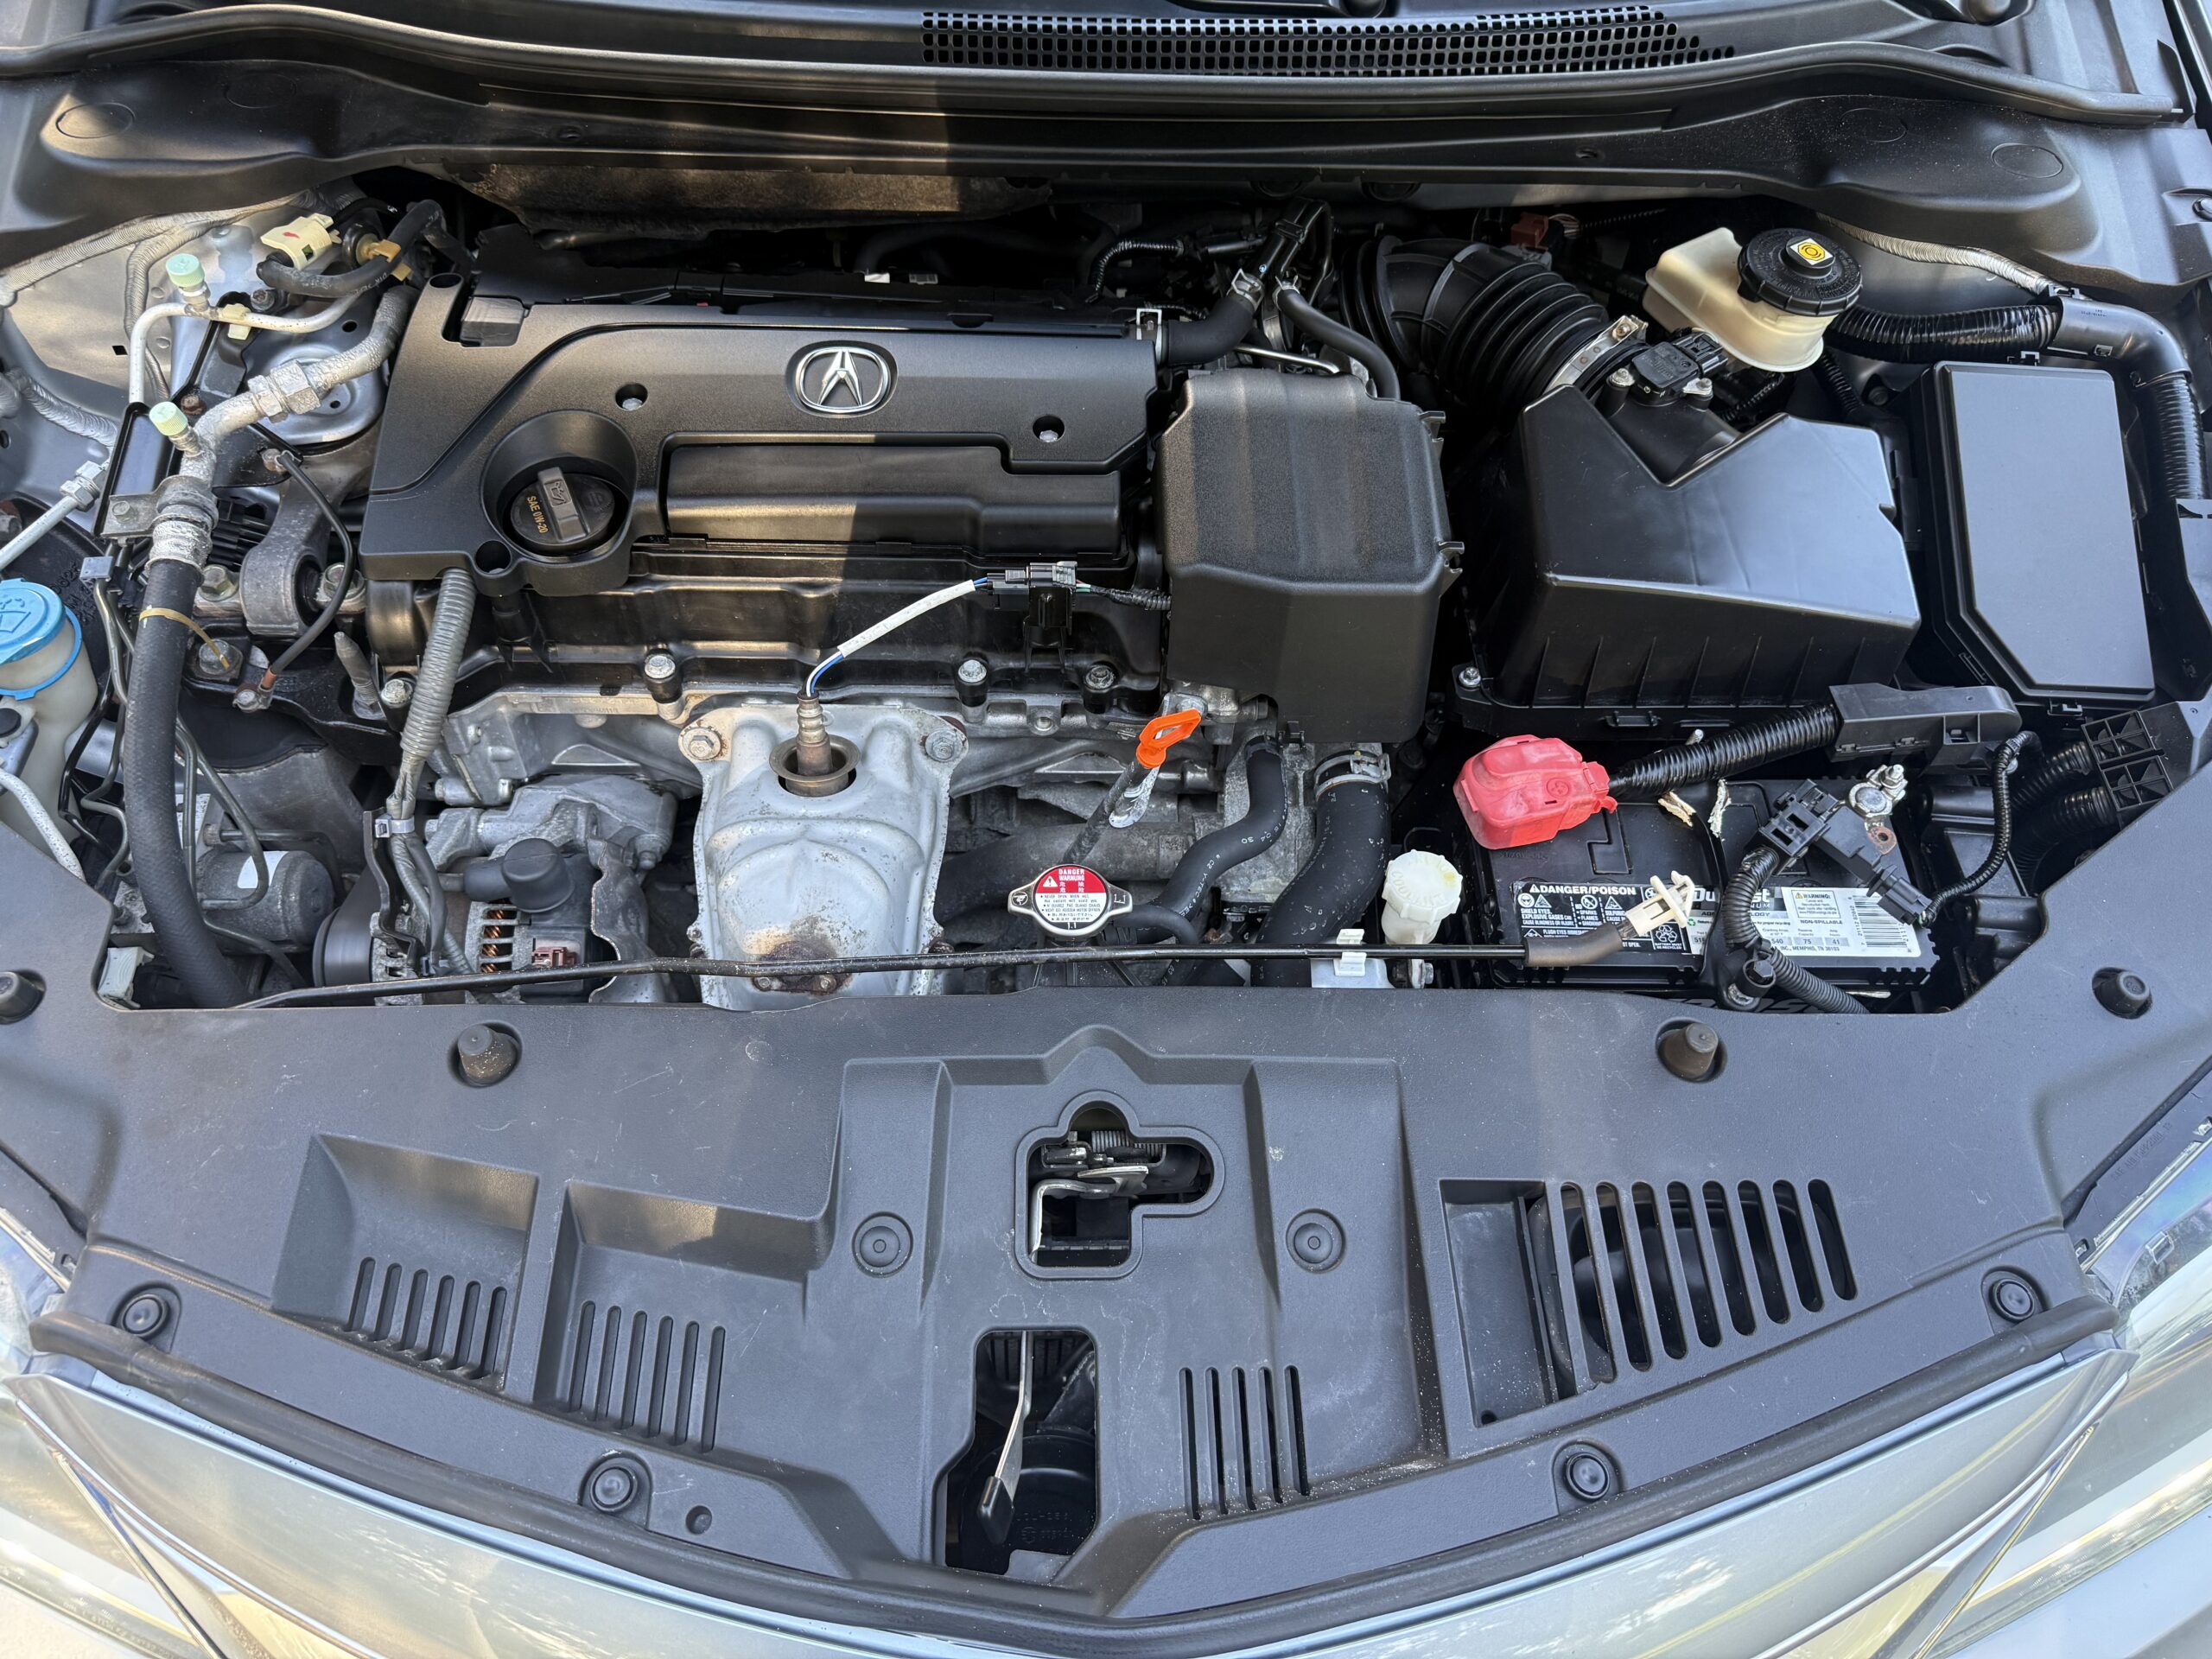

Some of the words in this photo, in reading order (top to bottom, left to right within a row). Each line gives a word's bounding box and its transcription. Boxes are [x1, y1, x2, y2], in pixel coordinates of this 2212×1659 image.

[527, 495, 541, 512] SAE
[533, 512, 549, 533] 0W-20
[1540, 885, 1637, 895] DANGER/POISON
